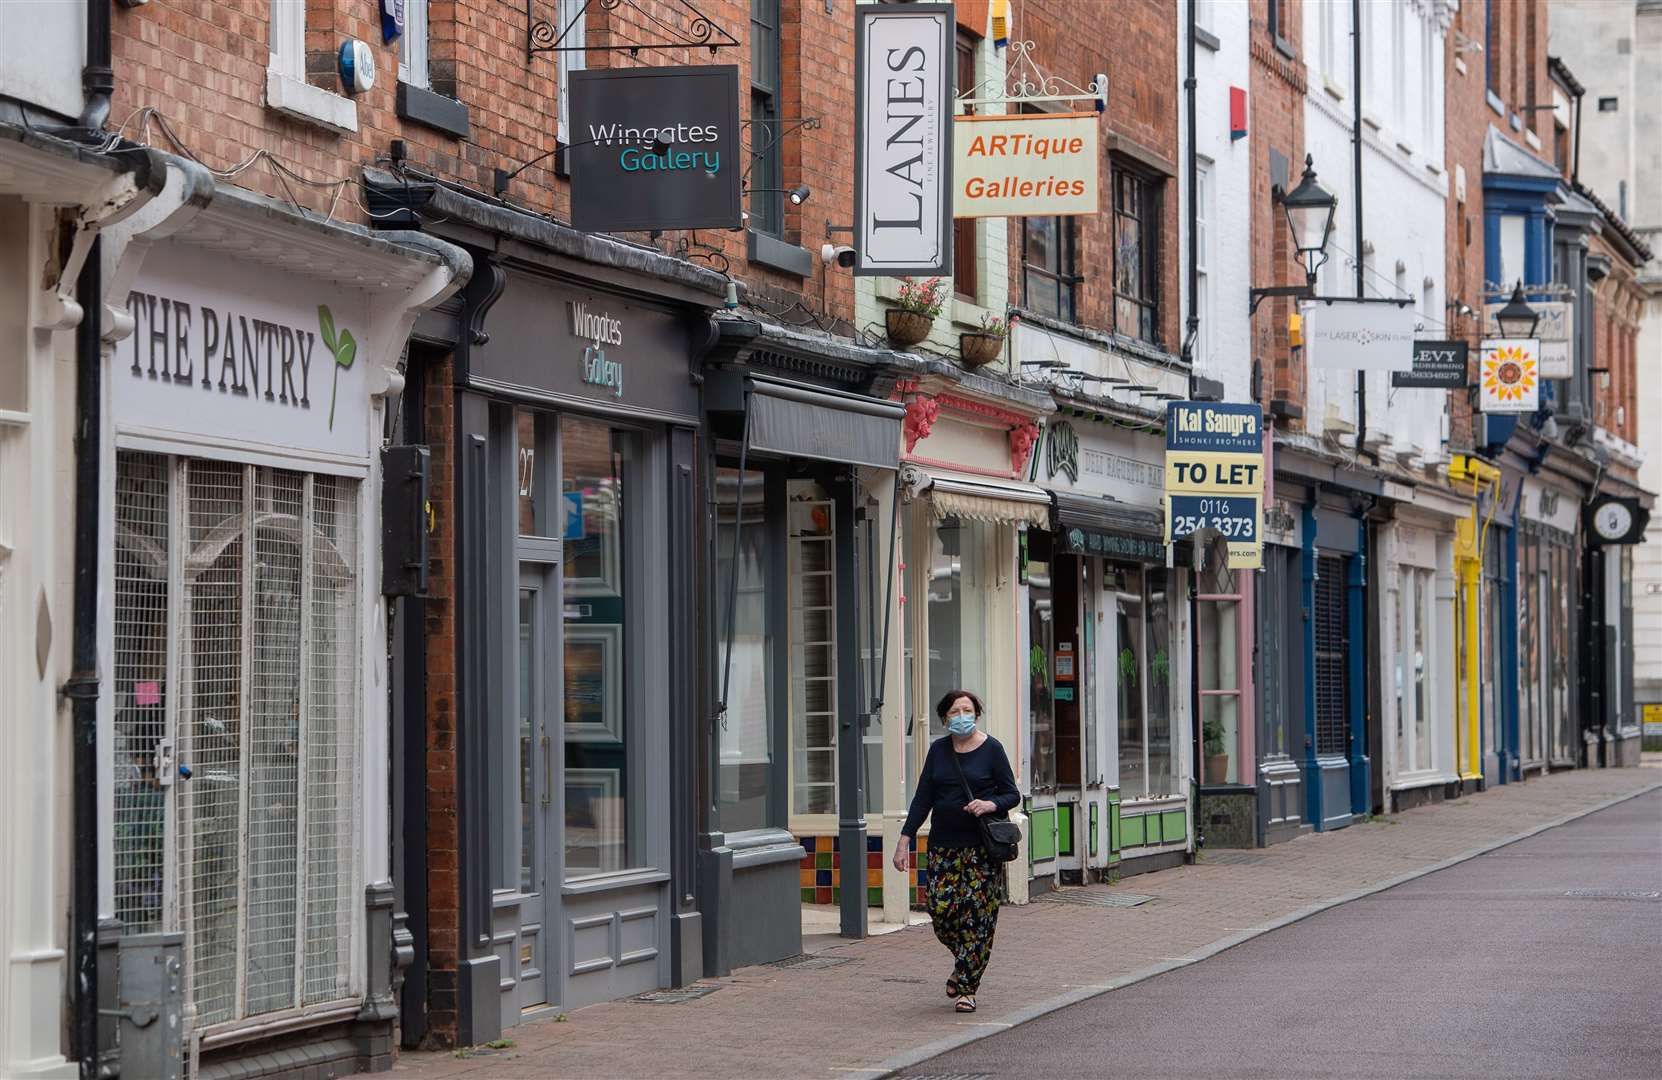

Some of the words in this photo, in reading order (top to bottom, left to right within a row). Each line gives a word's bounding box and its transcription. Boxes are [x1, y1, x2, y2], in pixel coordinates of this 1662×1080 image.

[589, 123, 718, 150] Wingates
[873, 46, 926, 235] LANES
[967, 134, 1083, 160] ARTique
[619, 147, 720, 174] Gallery
[965, 176, 1085, 198] Galleries
[572, 300, 622, 350] Wingates
[1329, 330, 1358, 341] LASER
[1371, 331, 1392, 342] SKIN
[126, 290, 193, 385] THE
[201, 306, 314, 408] PANTRY
[583, 347, 623, 398] Gallery
[1179, 408, 1202, 432] Kal
[1205, 409, 1256, 437] Sangra
[1179, 436, 1212, 445] SHONKI
[1216, 437, 1256, 446] BROTHERS
[519, 448, 534, 497] 27
[1174, 462, 1207, 484] TO
[1216, 463, 1258, 485] LET
[1200, 499, 1229, 515] 0116
[1174, 516, 1206, 535] 254
[1211, 517, 1253, 537] 3373
